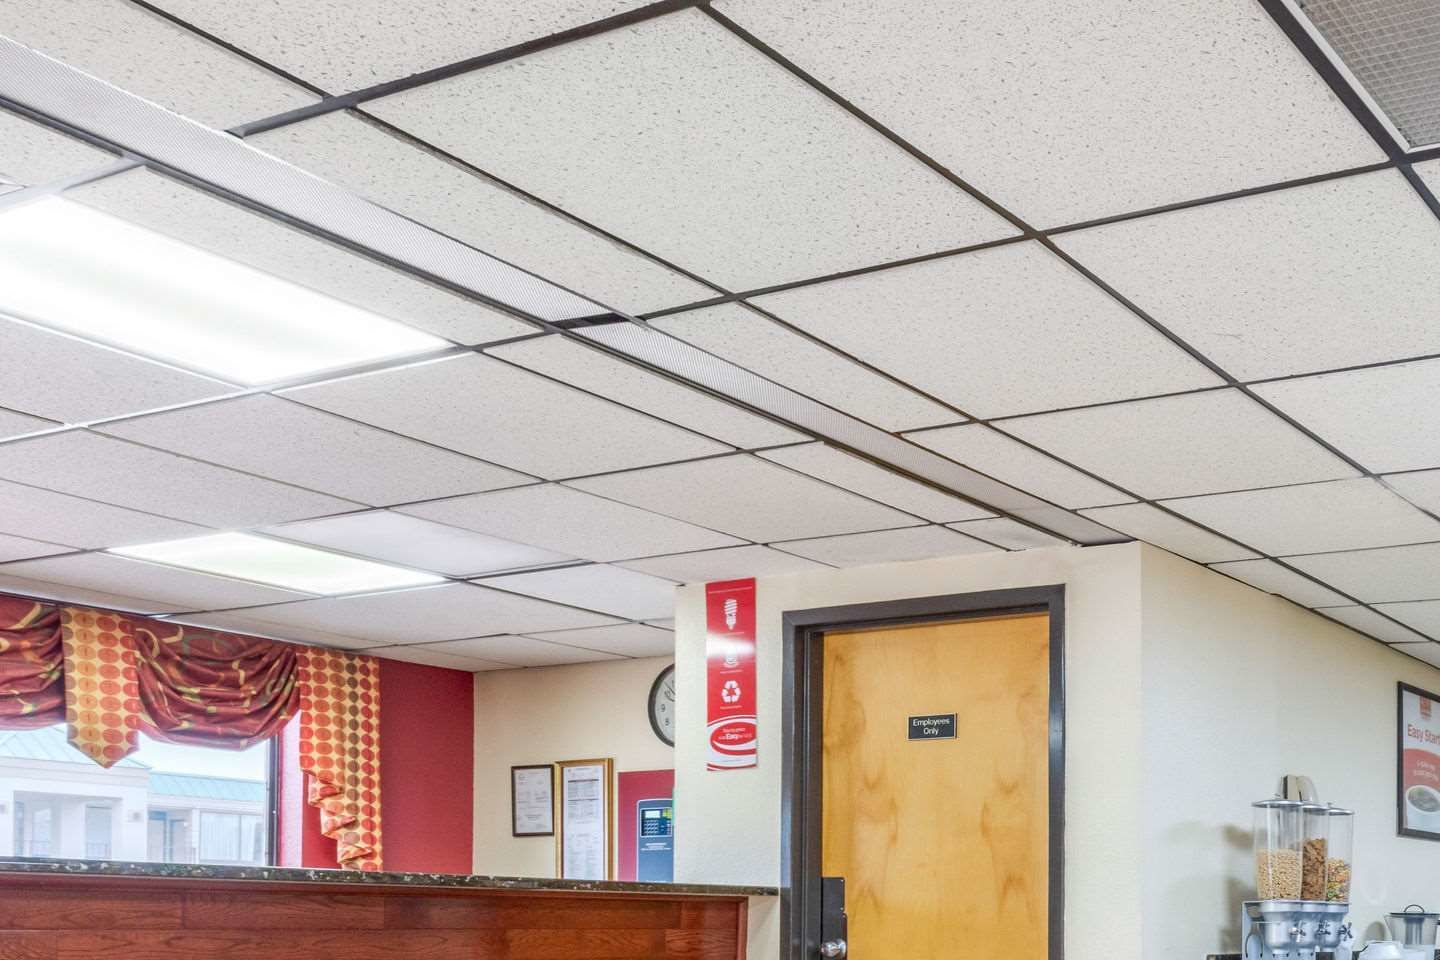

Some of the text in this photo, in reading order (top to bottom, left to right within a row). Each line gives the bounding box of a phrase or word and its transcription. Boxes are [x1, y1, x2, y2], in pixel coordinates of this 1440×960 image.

[912, 718, 950, 727] Employees
[923, 727, 939, 736] Only
[1407, 724, 1423, 743] Easy
